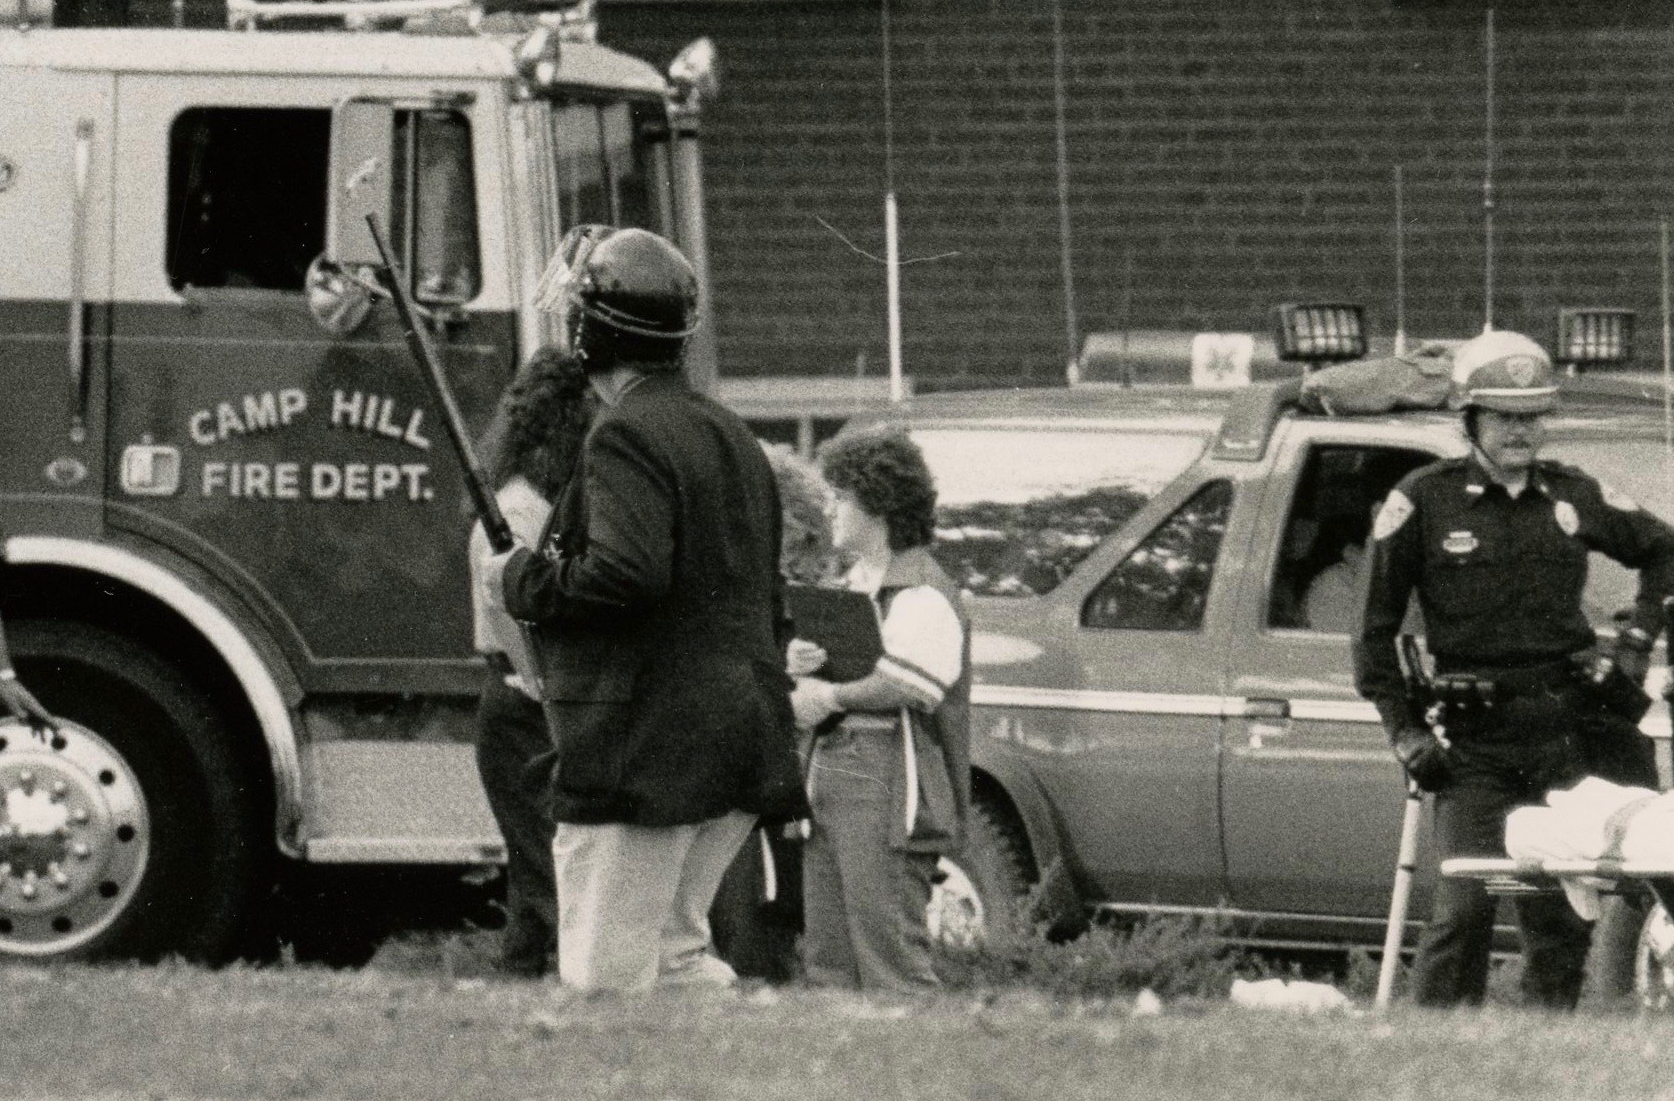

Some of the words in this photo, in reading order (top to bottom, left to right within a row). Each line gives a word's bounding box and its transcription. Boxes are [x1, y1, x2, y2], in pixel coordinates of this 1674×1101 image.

[188, 387, 309, 446] CAMP
[330, 389, 431, 449] HILL
[202, 462, 301, 499] FIRE
[311, 462, 435, 501] DEPT.
